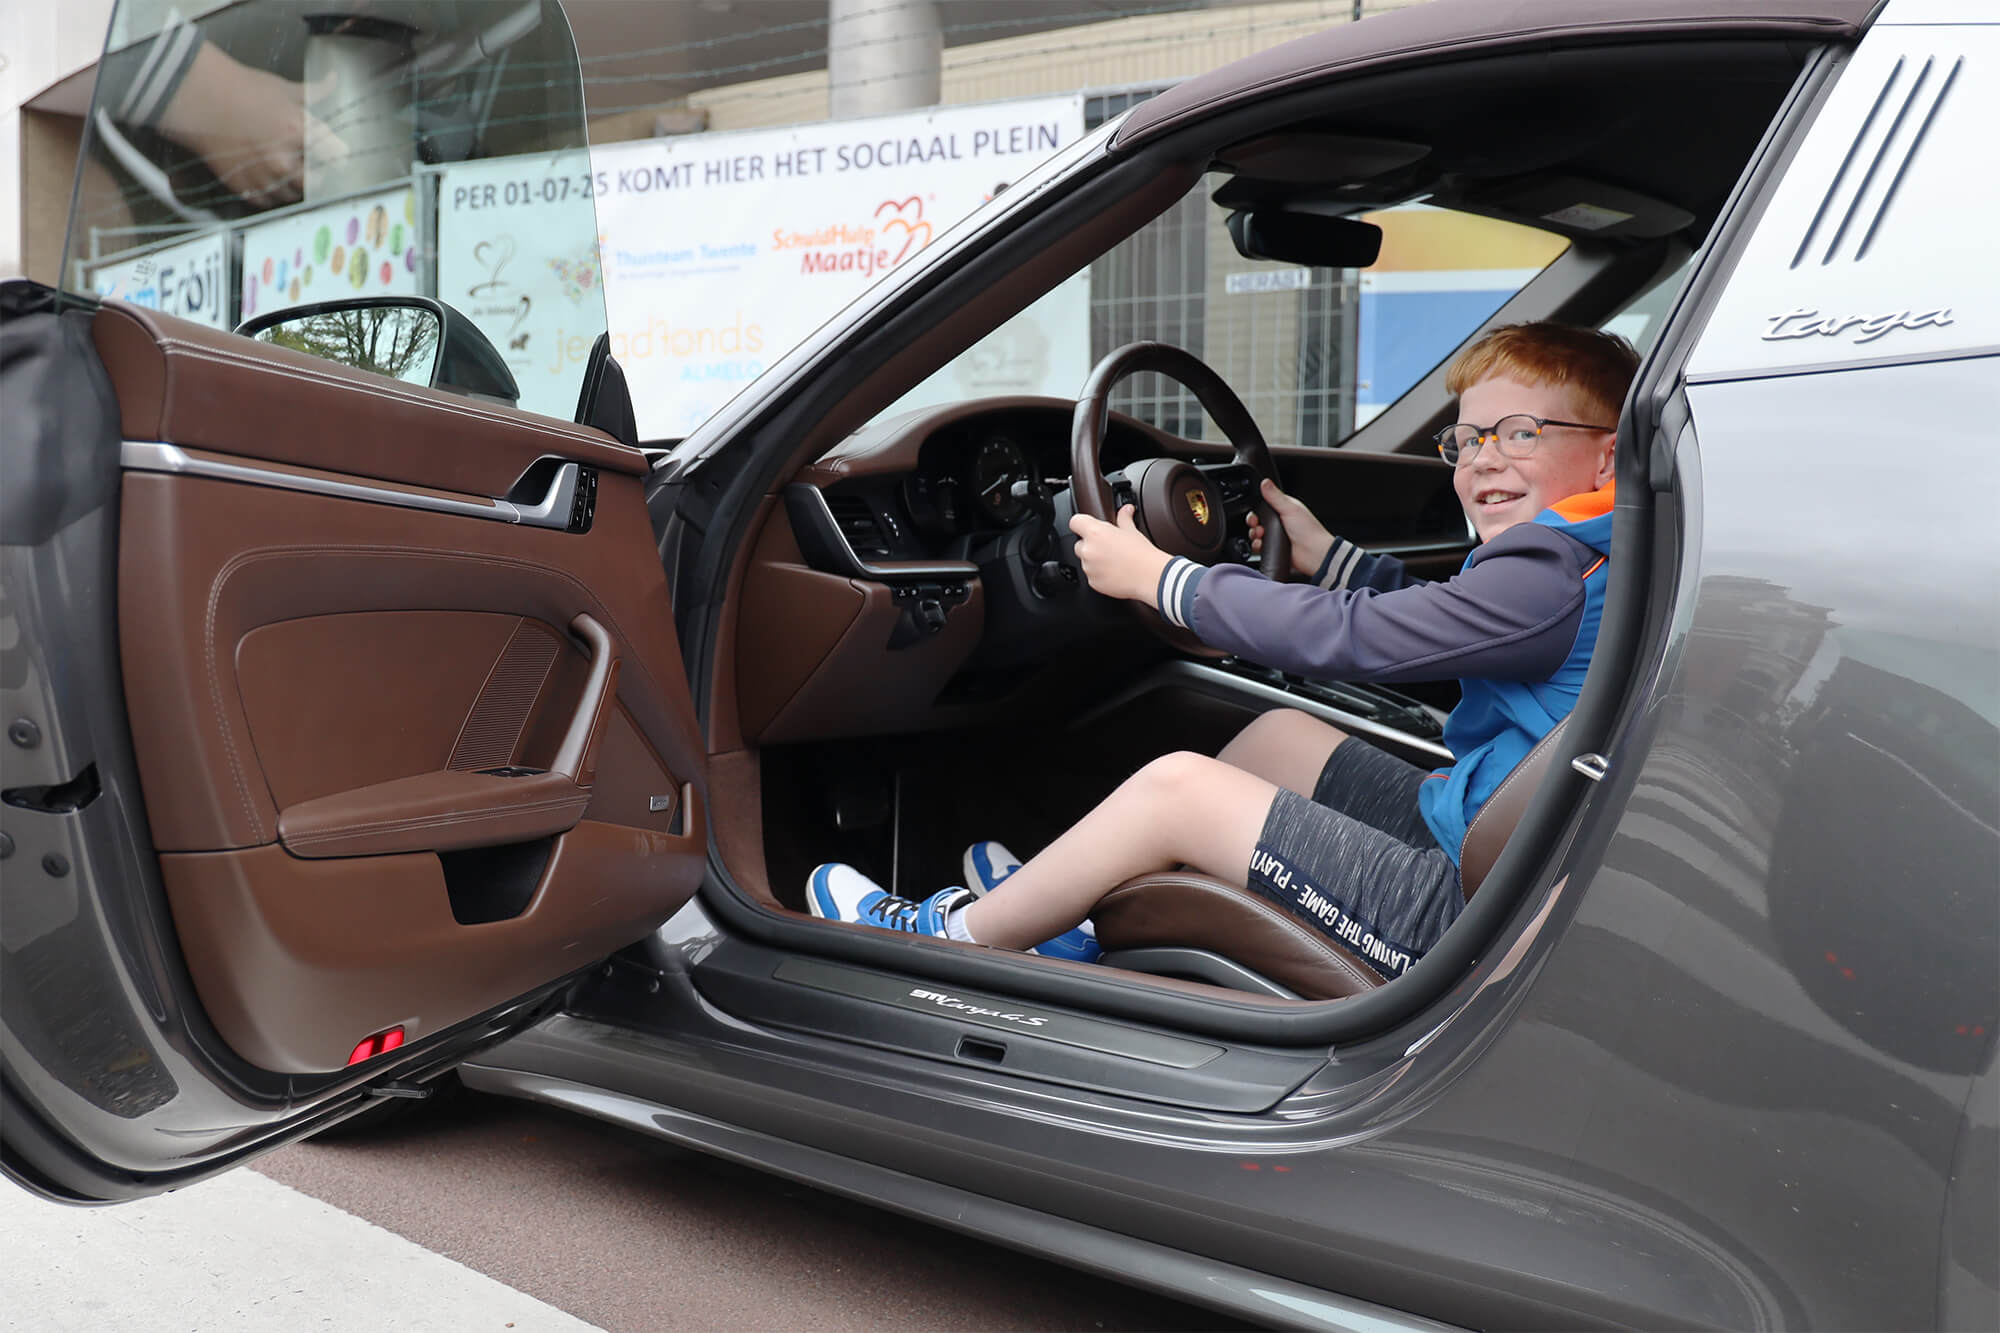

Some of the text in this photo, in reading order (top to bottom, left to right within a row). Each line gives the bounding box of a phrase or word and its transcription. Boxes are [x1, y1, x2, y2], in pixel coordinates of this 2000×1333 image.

[454, 123, 1060, 211] PER 01-07-25 KOMT HIER HET SOCIAAL PLEIN
[801, 247, 889, 279] Maatje
[548, 310, 764, 375] jegdfonds
[1761, 307, 1954, 345] targa
[1297, 883, 1340, 927] GAME
[1335, 914, 1365, 947] THE
